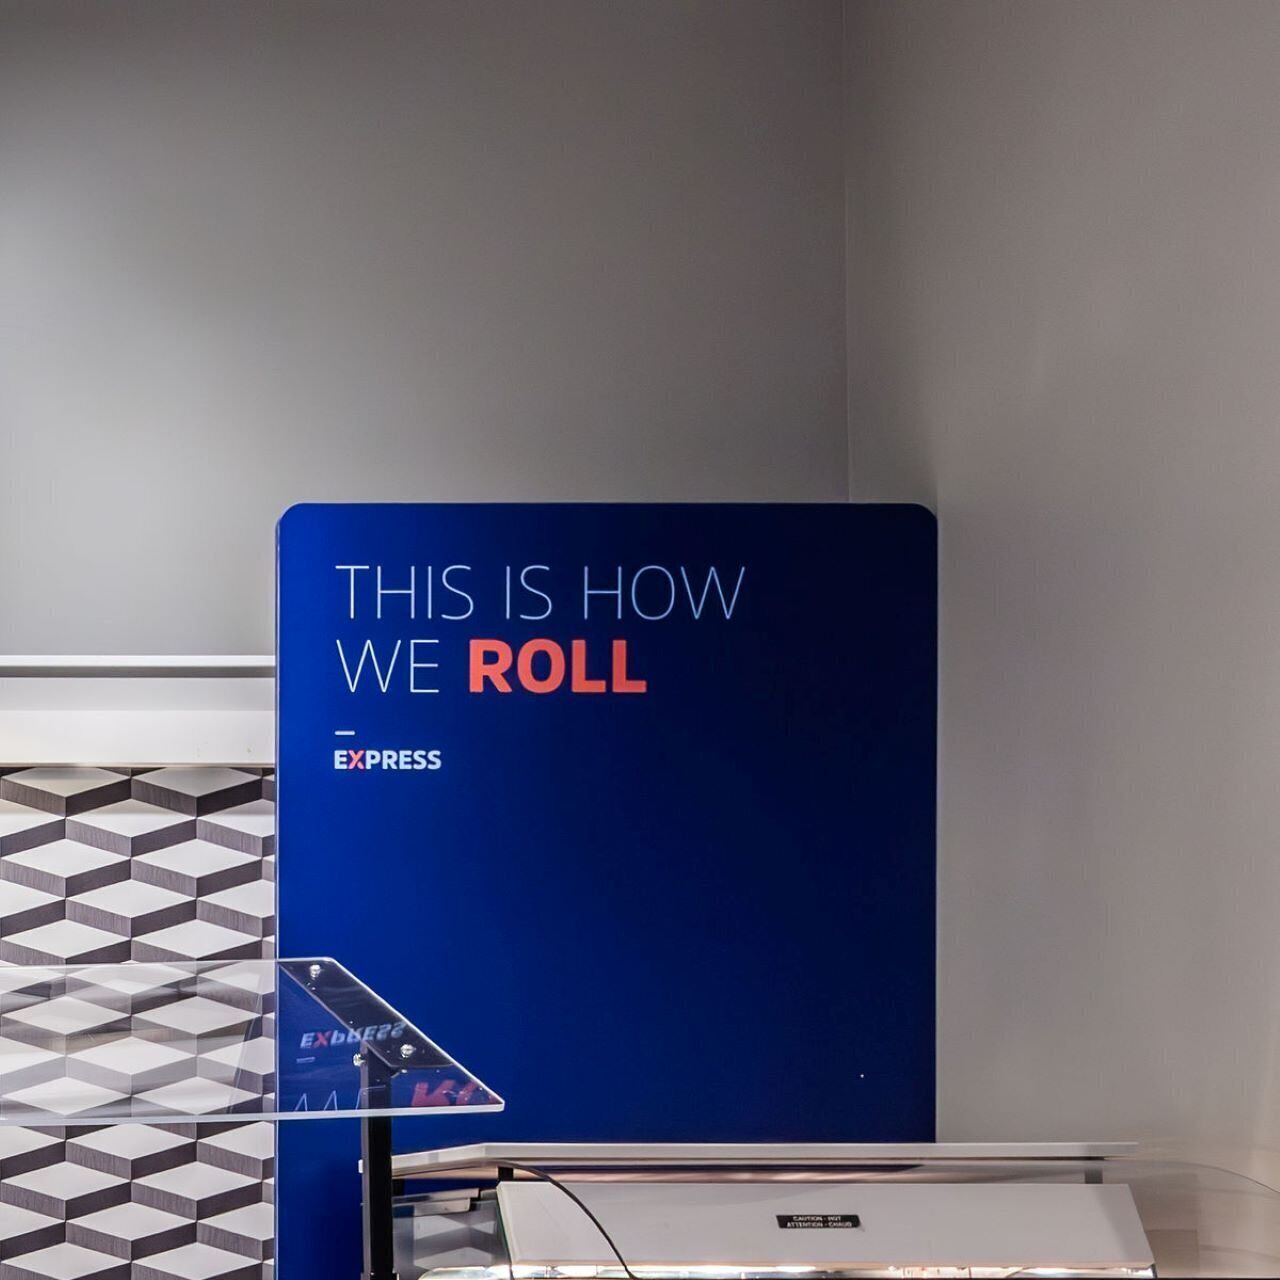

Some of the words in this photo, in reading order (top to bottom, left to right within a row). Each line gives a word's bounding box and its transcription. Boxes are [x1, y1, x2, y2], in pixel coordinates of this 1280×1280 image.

[335, 564, 475, 621] THIS
[505, 564, 553, 621] IS
[583, 564, 746, 621] HOW
[336, 639, 440, 694] WE
[468, 638, 647, 694] ROLL
[333, 749, 442, 771] EXPRESS
